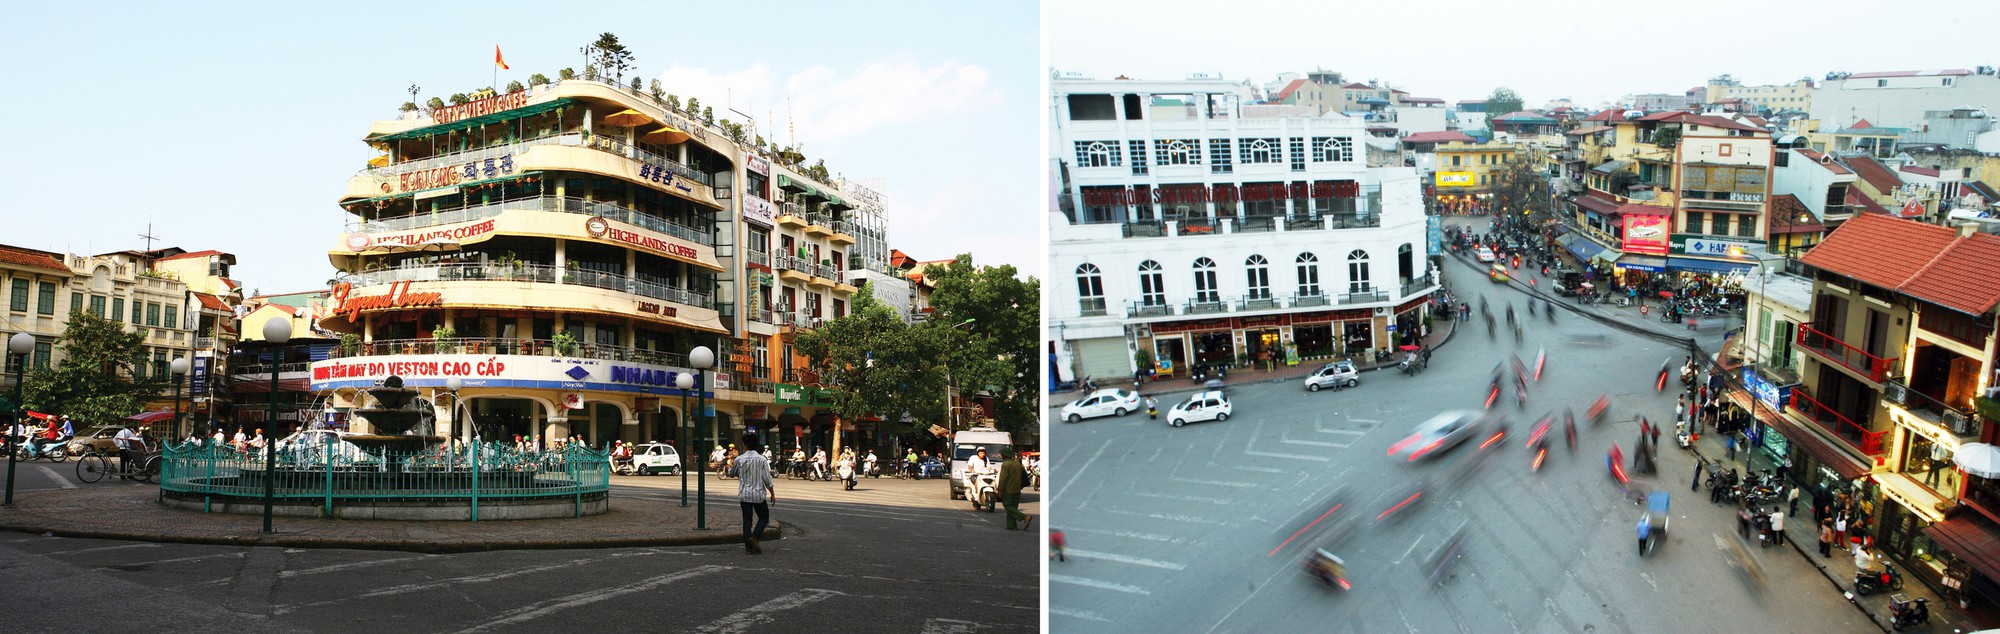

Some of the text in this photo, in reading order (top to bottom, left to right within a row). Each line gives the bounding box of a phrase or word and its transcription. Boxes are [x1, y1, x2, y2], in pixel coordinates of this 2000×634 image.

[433, 104, 461, 125] CITY
[463, 97, 495, 119] VIEW
[454, 219, 495, 239] COFFEE
[608, 227, 698, 259] HIGHLANDS COFFEE
[1669, 241, 1685, 249] Hapro
[333, 280, 442, 323] Legend beer
[313, 367, 331, 380] TRUNG
[348, 363, 366, 378] MAY
[368, 362, 385, 377] ĐO
[388, 361, 438, 376] VESTON
[442, 361, 471, 376] CAO
[476, 356, 505, 377] CẤP
